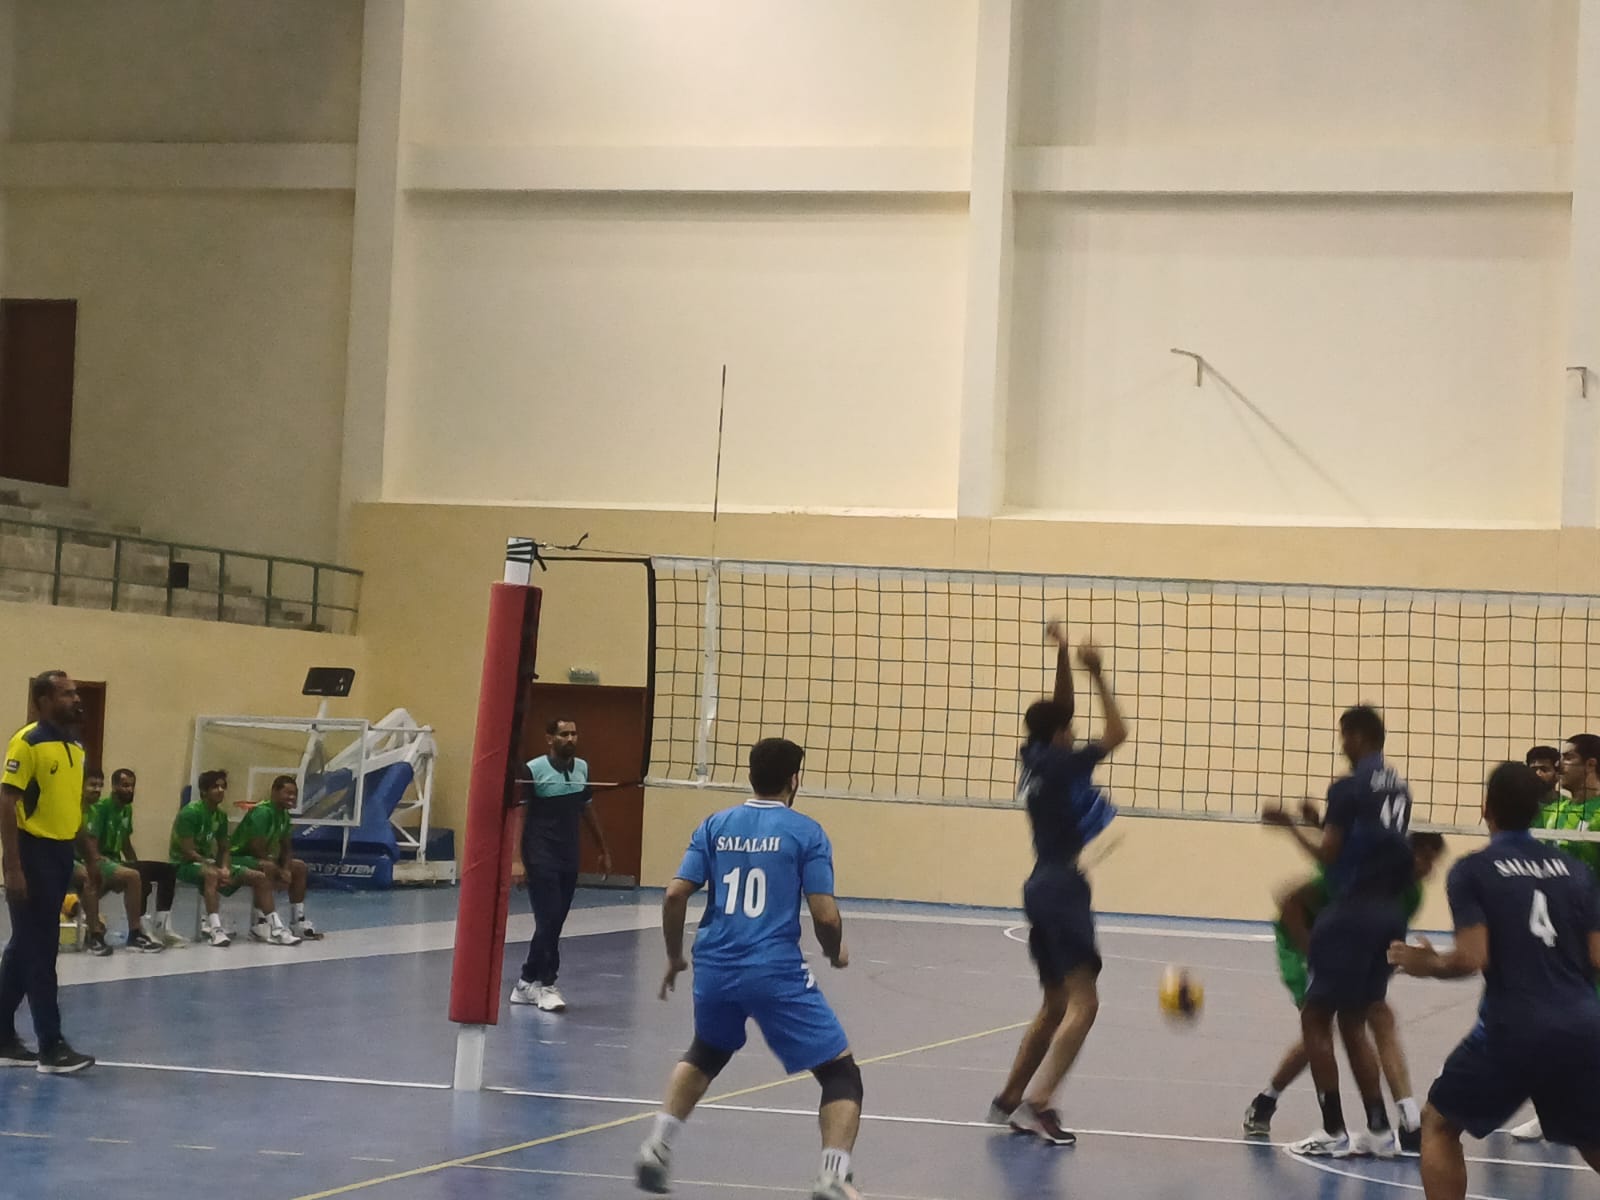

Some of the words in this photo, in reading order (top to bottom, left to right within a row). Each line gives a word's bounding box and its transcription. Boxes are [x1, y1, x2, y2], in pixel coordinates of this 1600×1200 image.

[716, 836, 780, 852] SALALAH
[722, 866, 767, 918] 10
[1529, 888, 1558, 948] 4
